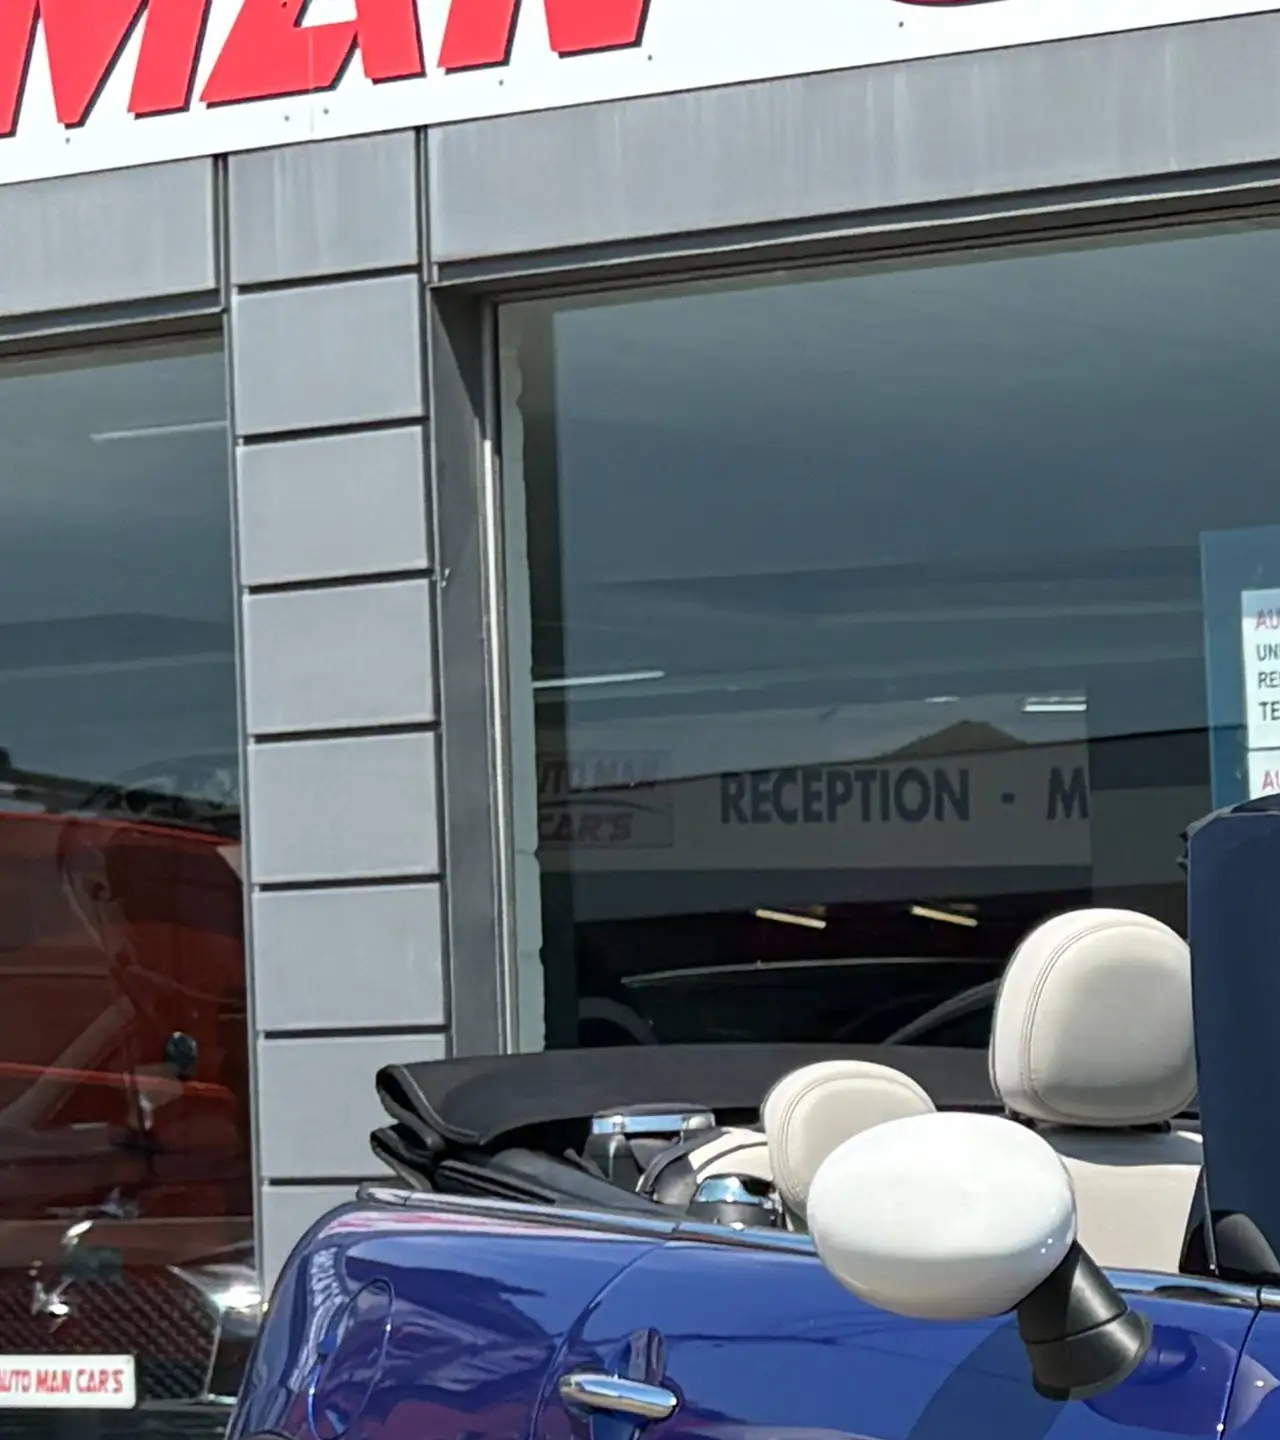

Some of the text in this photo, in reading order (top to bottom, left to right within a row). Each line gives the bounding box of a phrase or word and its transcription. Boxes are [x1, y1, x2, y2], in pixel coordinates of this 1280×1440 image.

[719, 766, 970, 825] RECEPTION
[0, 1368, 31, 1393] UTO
[36, 1368, 71, 1393] MAN
